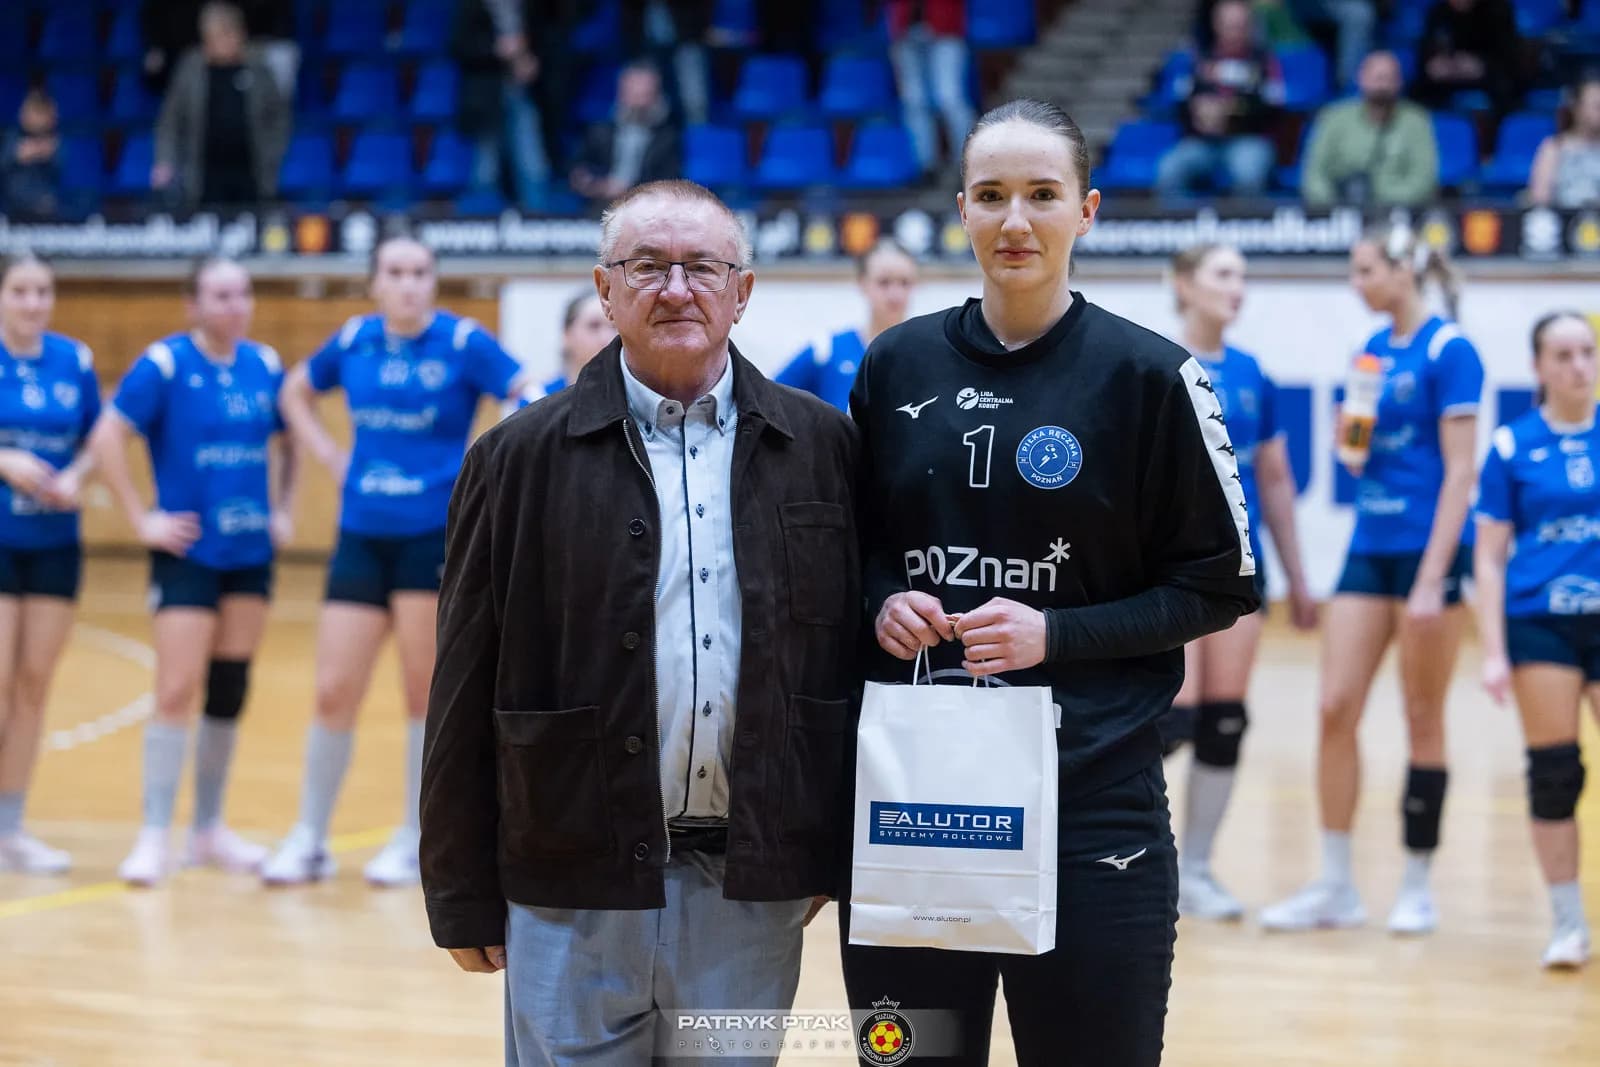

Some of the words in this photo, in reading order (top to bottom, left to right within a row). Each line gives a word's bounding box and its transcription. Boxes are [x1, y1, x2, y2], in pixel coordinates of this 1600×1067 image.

[963, 424, 995, 488] 1
[896, 811, 1012, 830] ALUTOR
[879, 830, 935, 839] SYSTEMY
[942, 833, 1012, 842] ROLETOWE
[912, 915, 972, 924] www.alutor.pl
